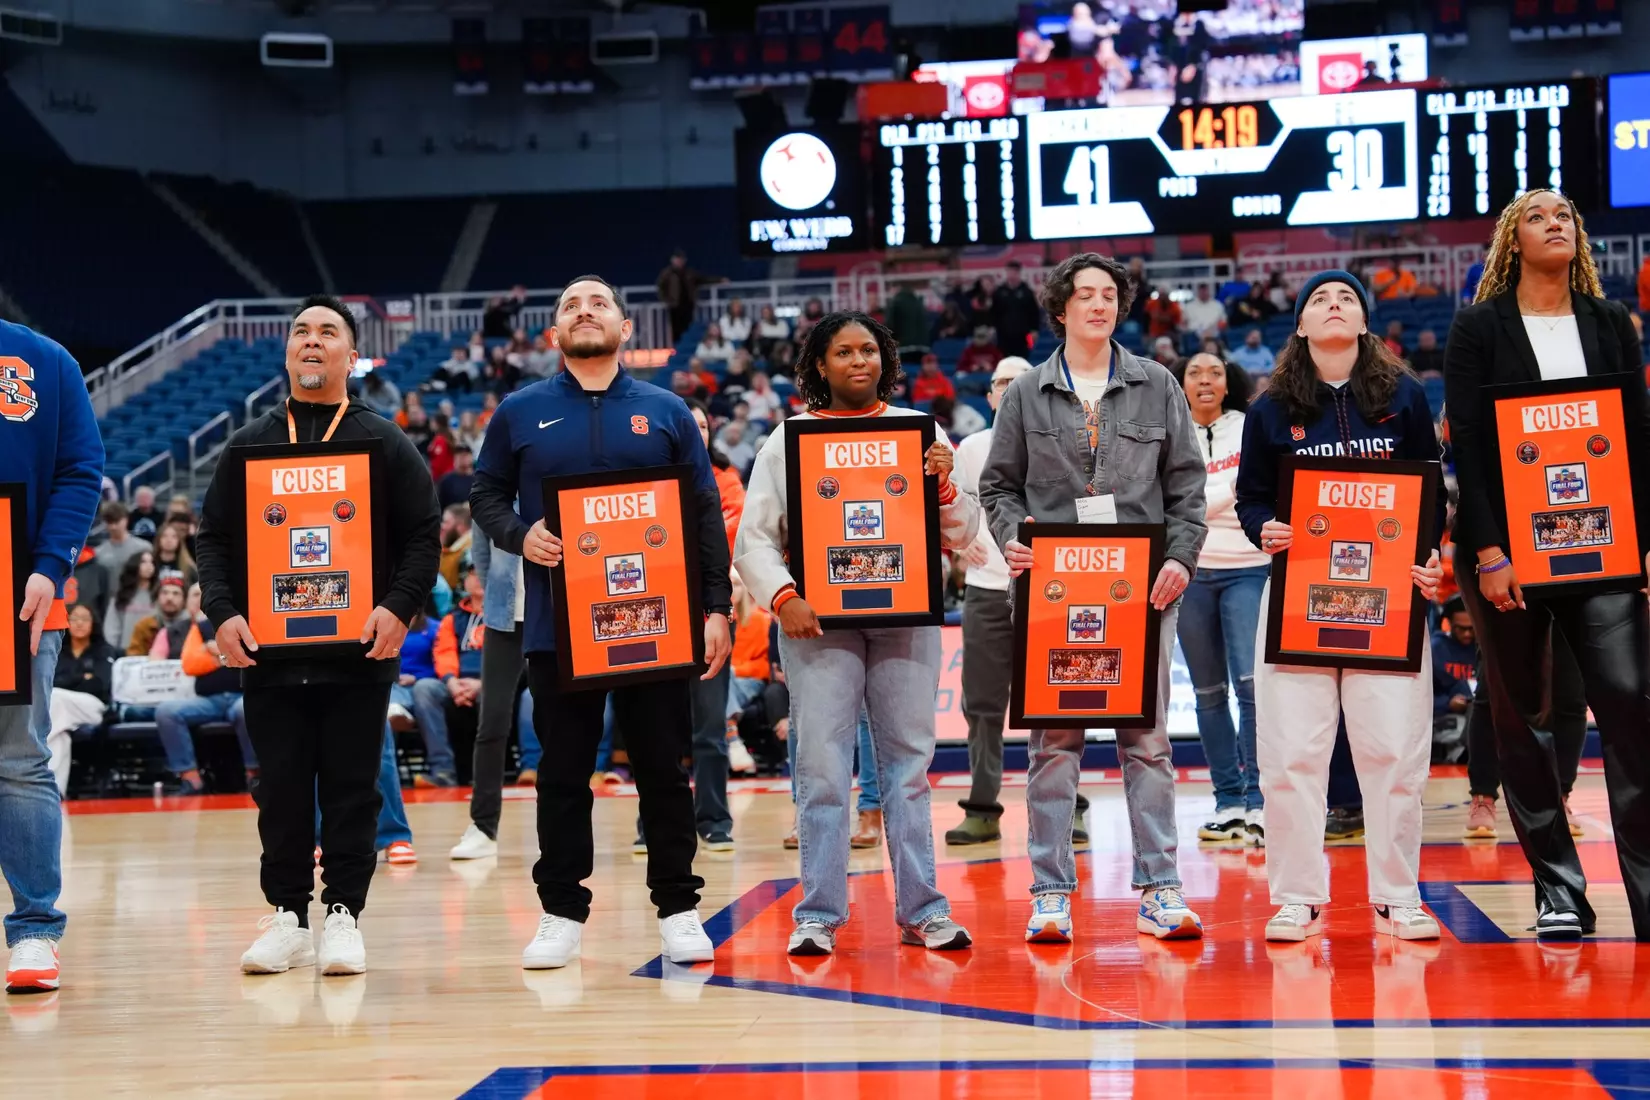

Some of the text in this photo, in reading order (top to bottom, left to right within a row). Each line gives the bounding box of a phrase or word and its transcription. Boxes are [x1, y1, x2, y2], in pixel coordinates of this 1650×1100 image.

[834, 20, 888, 54] 44
[1177, 105, 1258, 150] 14:19
[1614, 119, 1650, 150] ST
[1326, 128, 1383, 190] 30
[1063, 144, 1110, 205] 41
[630, 415, 649, 435] S
[1525, 402, 1592, 431] 'CUSE
[828, 441, 891, 466] 'CUSE
[275, 466, 339, 493] 'CUSE
[586, 492, 650, 521] 'CUSE
[1322, 482, 1388, 509] 'CUSE
[1058, 548, 1119, 571] 'CUSE
